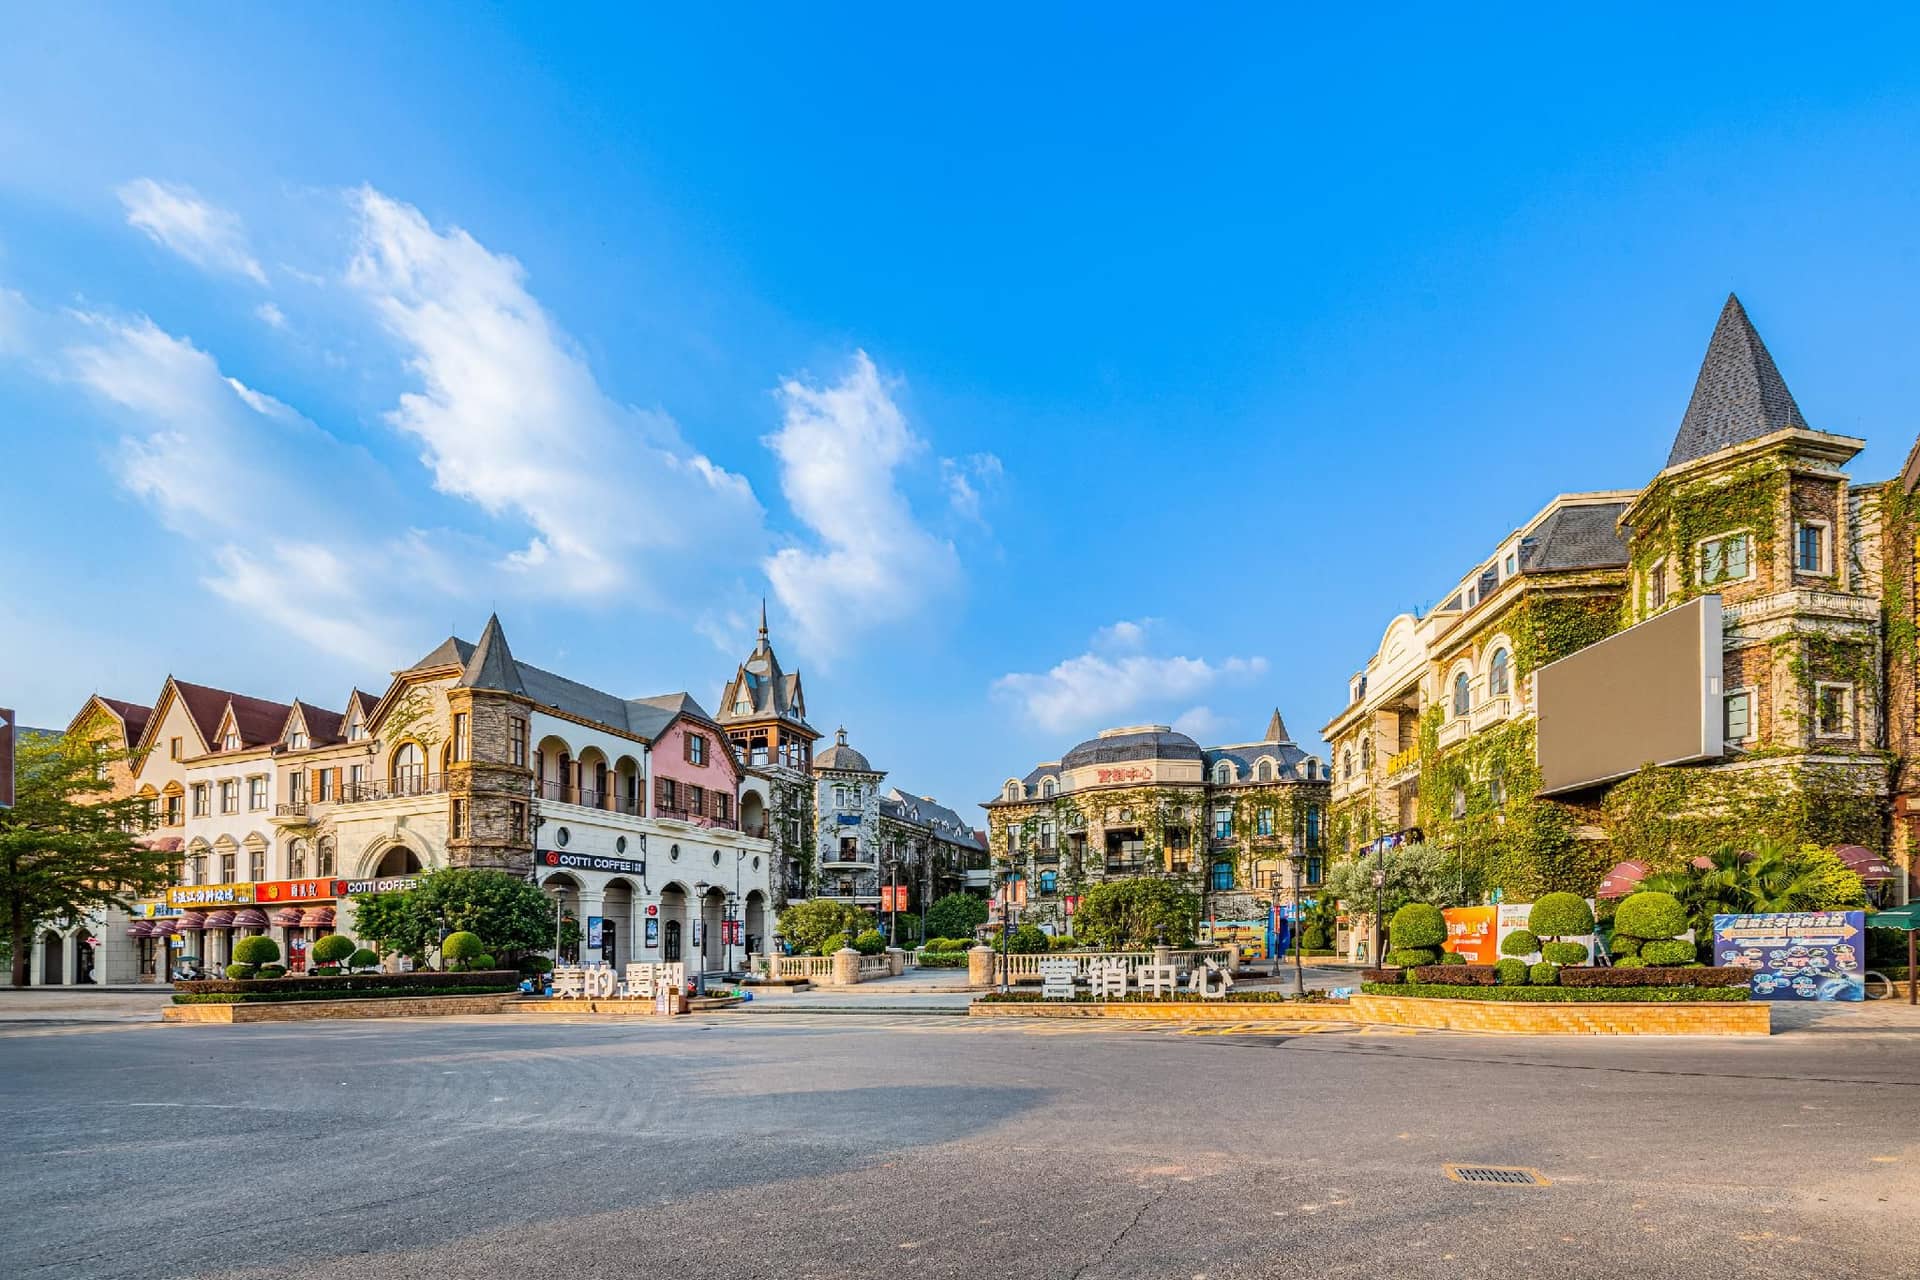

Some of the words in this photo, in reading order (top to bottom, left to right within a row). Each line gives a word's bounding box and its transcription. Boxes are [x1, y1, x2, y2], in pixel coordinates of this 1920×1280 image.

[560, 855, 591, 867] COTTI
[594, 860, 631, 871] COFFEE
[347, 881, 376, 893] COTTI
[378, 879, 417, 891] COFFEE
[1039, 956, 1234, 999] 营销中心
